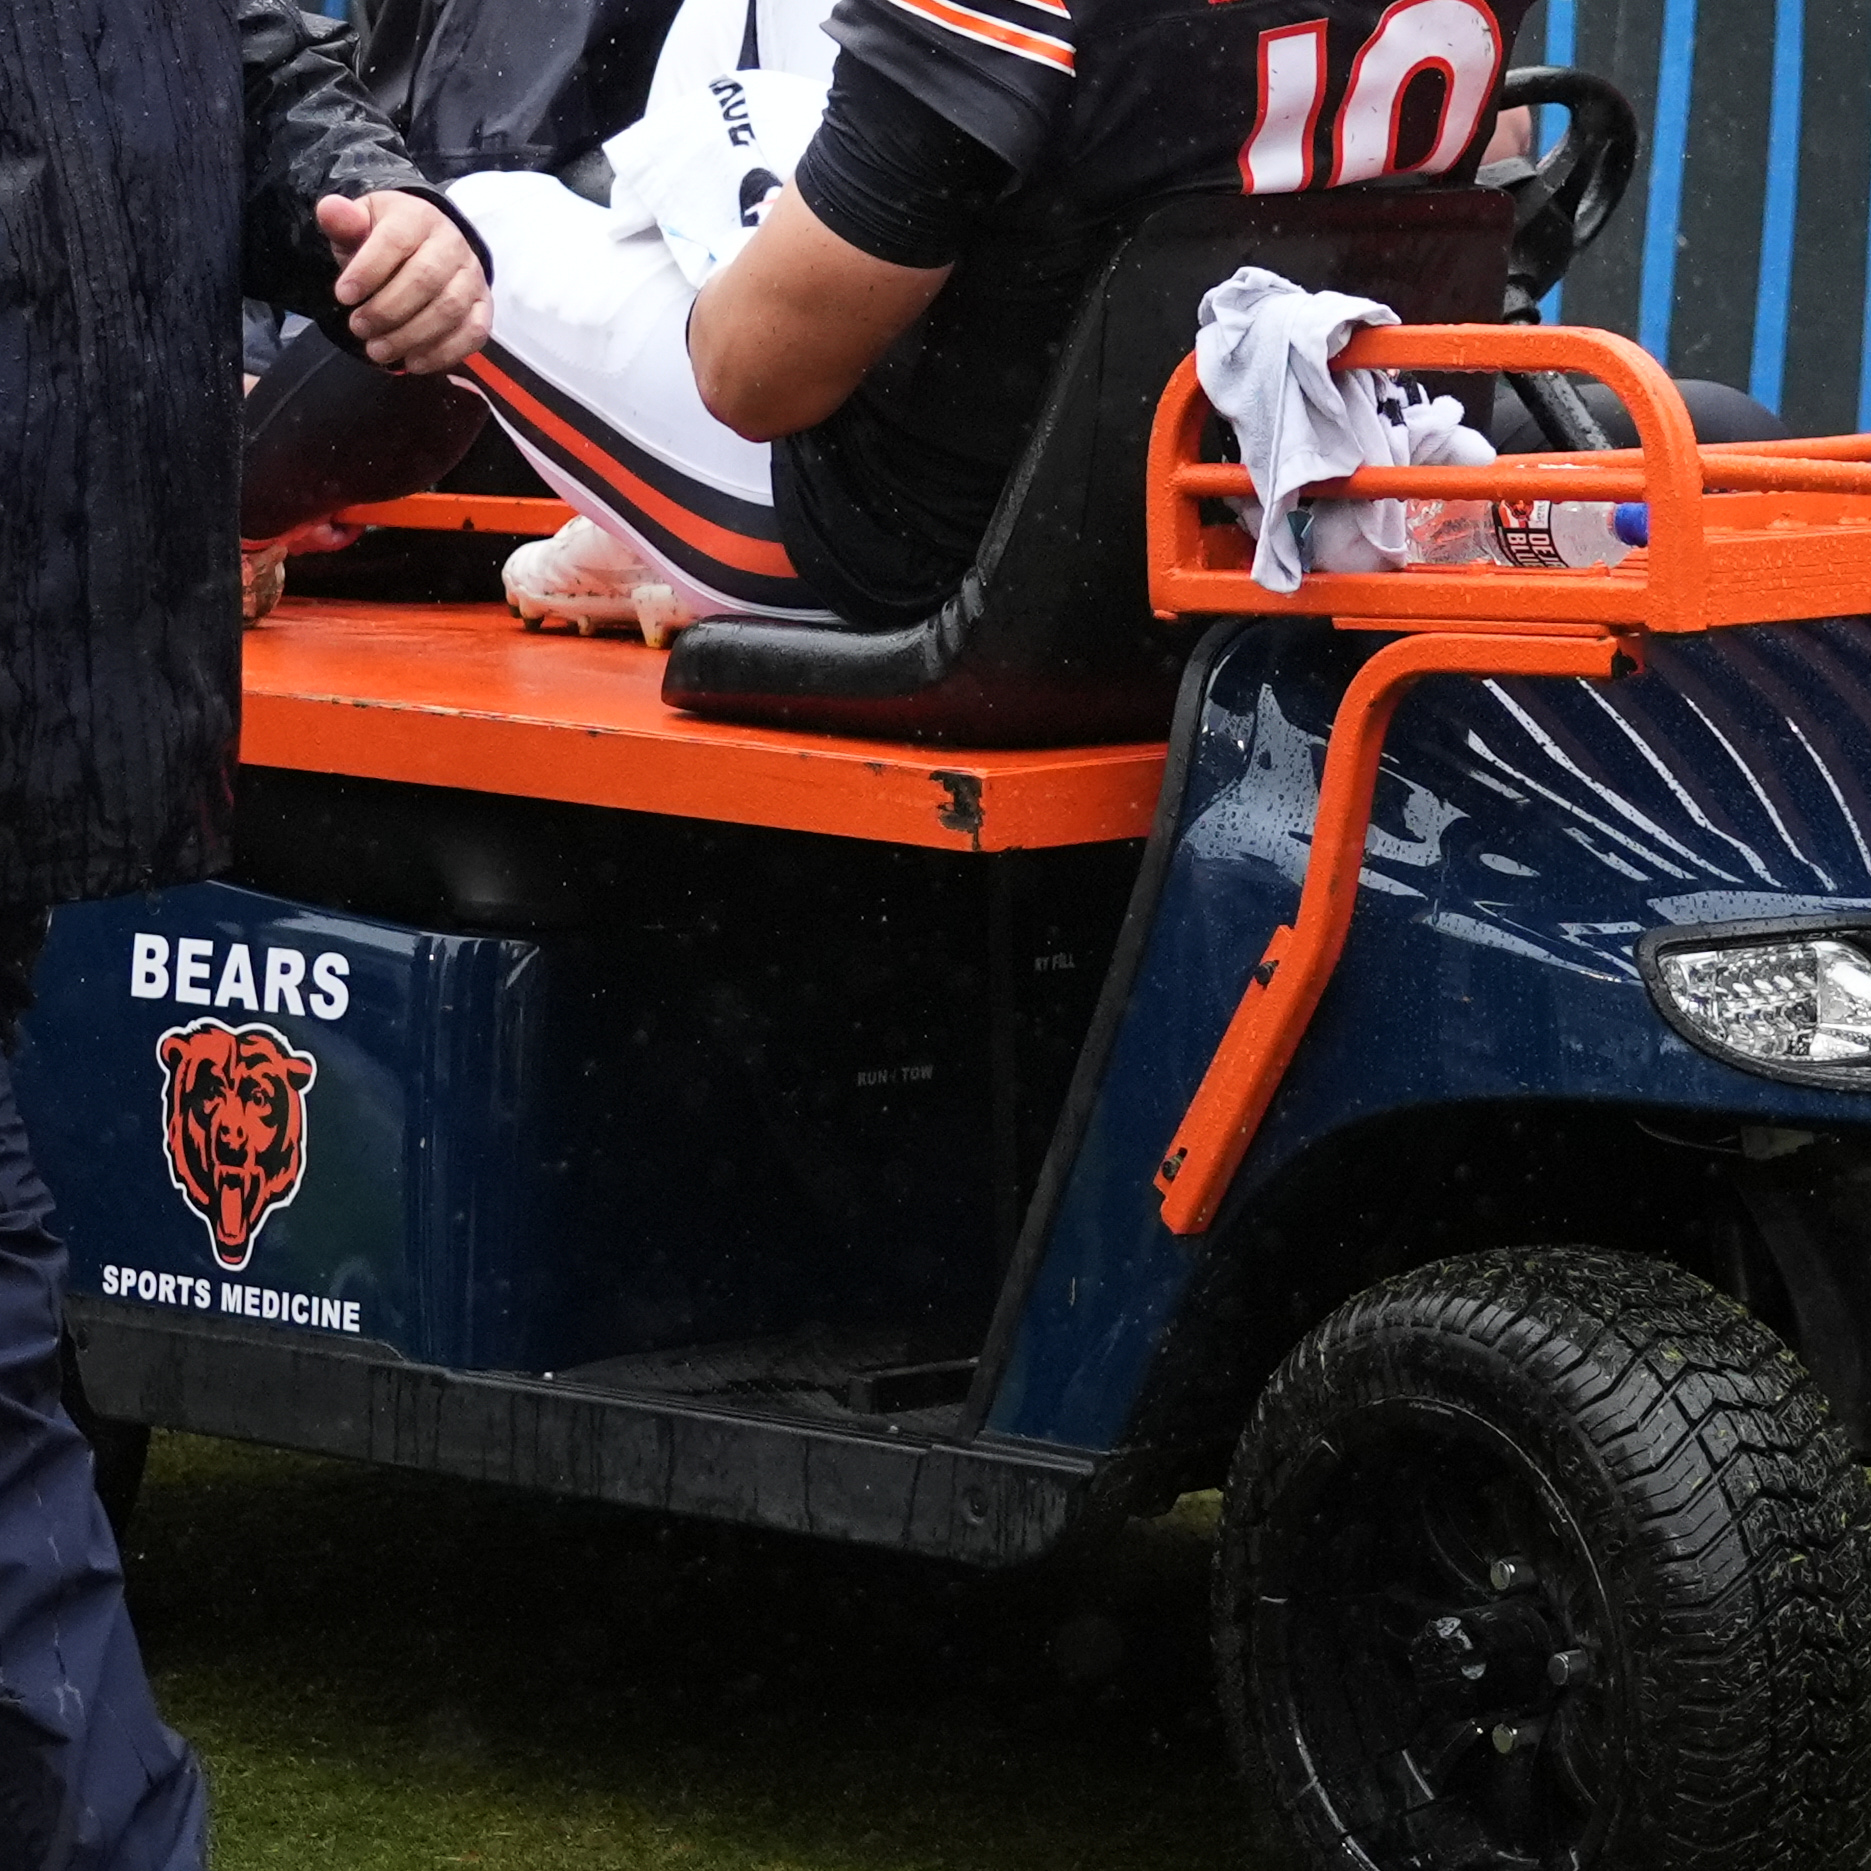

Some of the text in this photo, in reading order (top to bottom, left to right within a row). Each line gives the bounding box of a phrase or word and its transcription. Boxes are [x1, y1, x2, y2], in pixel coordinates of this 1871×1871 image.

[131, 932, 350, 1021] BEARS
[857, 1069, 888, 1087] RUN
[901, 1064, 934, 1083] TOW
[102, 1264, 361, 1333] SPORTS MEDICINE
